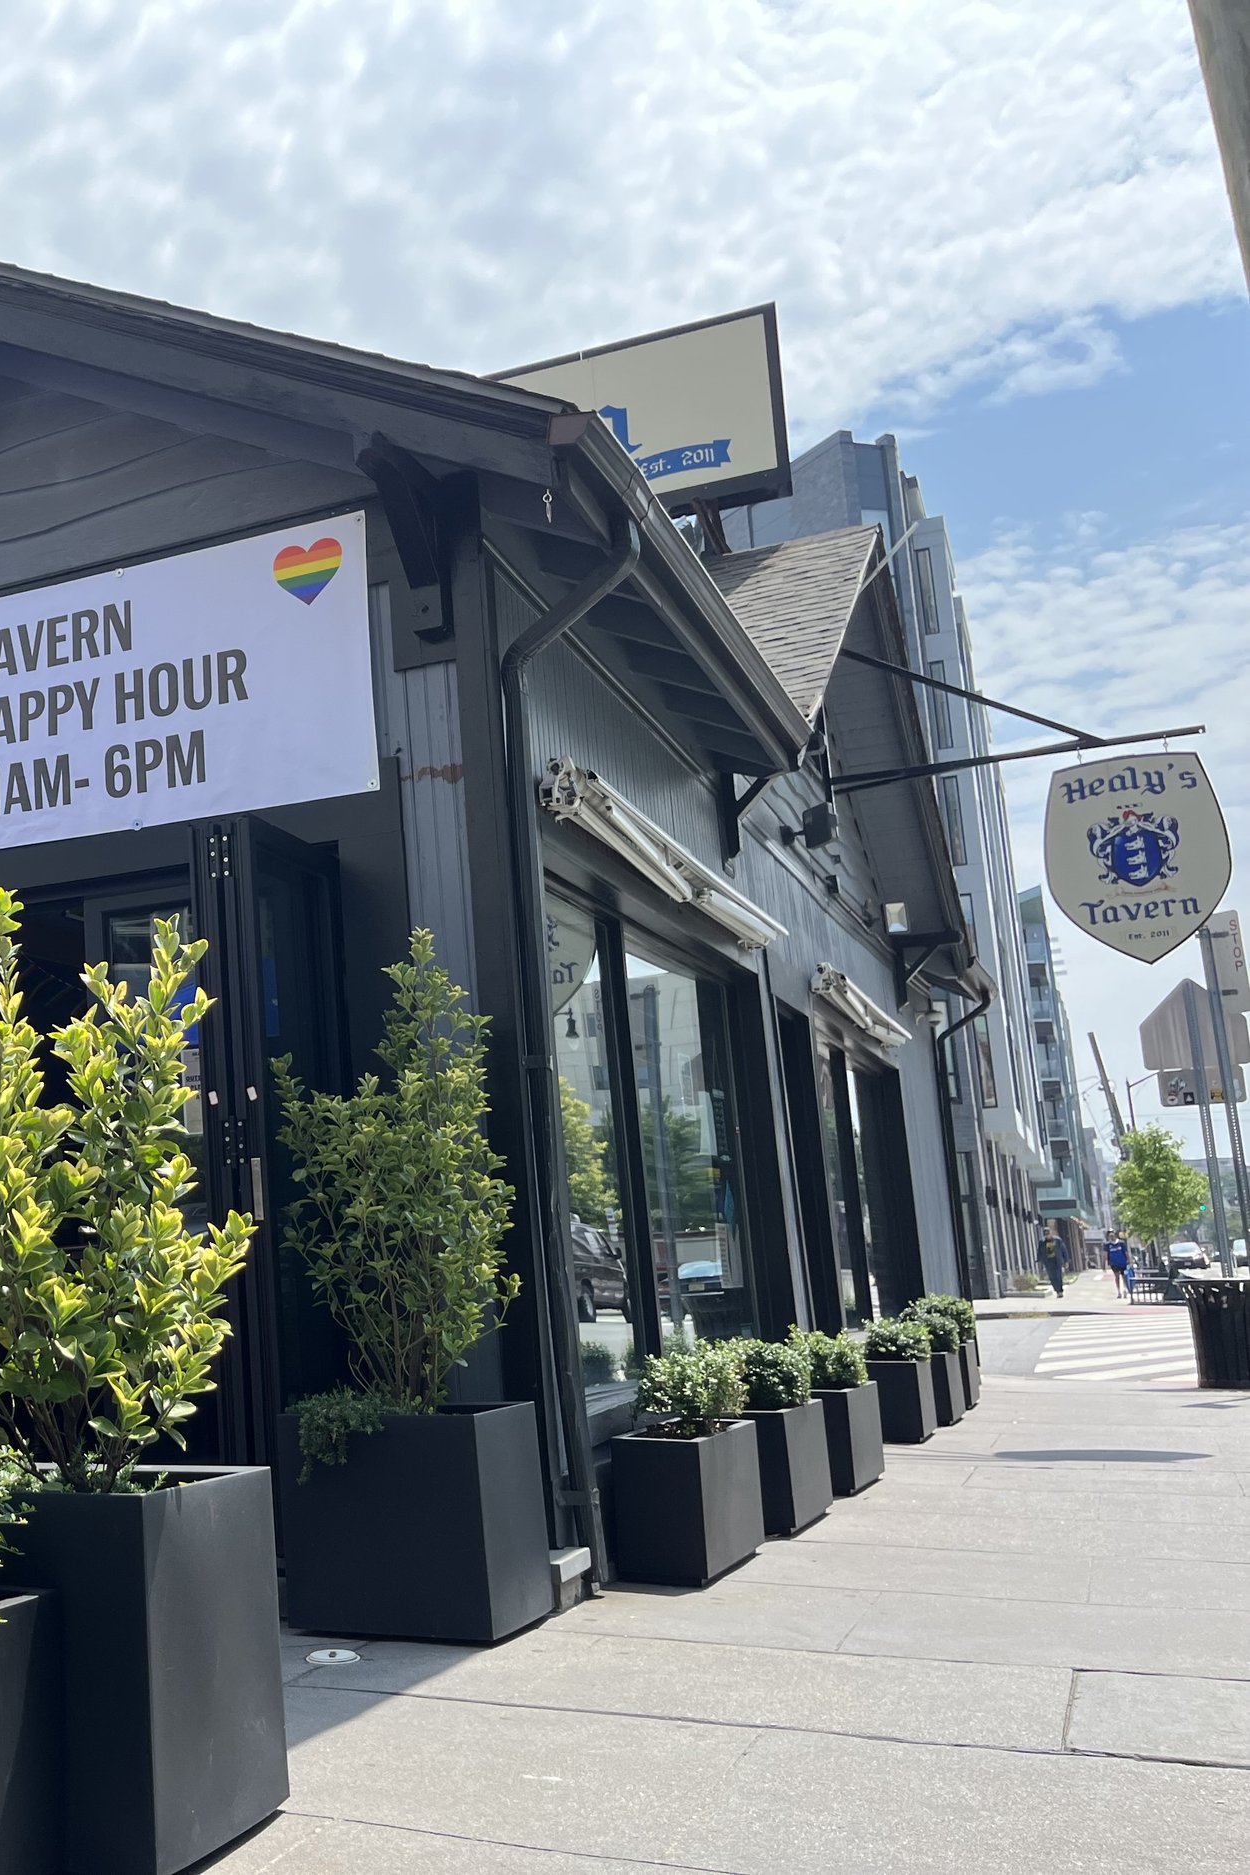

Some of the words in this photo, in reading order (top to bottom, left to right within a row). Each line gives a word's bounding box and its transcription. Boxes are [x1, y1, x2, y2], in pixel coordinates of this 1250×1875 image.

[681, 448, 715, 466] 2011
[114, 649, 249, 724] HOUR
[104, 729, 207, 798] 6PM
[1059, 763, 1198, 804] Healy's
[1078, 896, 1202, 925] Tavern
[1150, 930, 1170, 938] 2011
[1229, 919, 1243, 972] STOP
